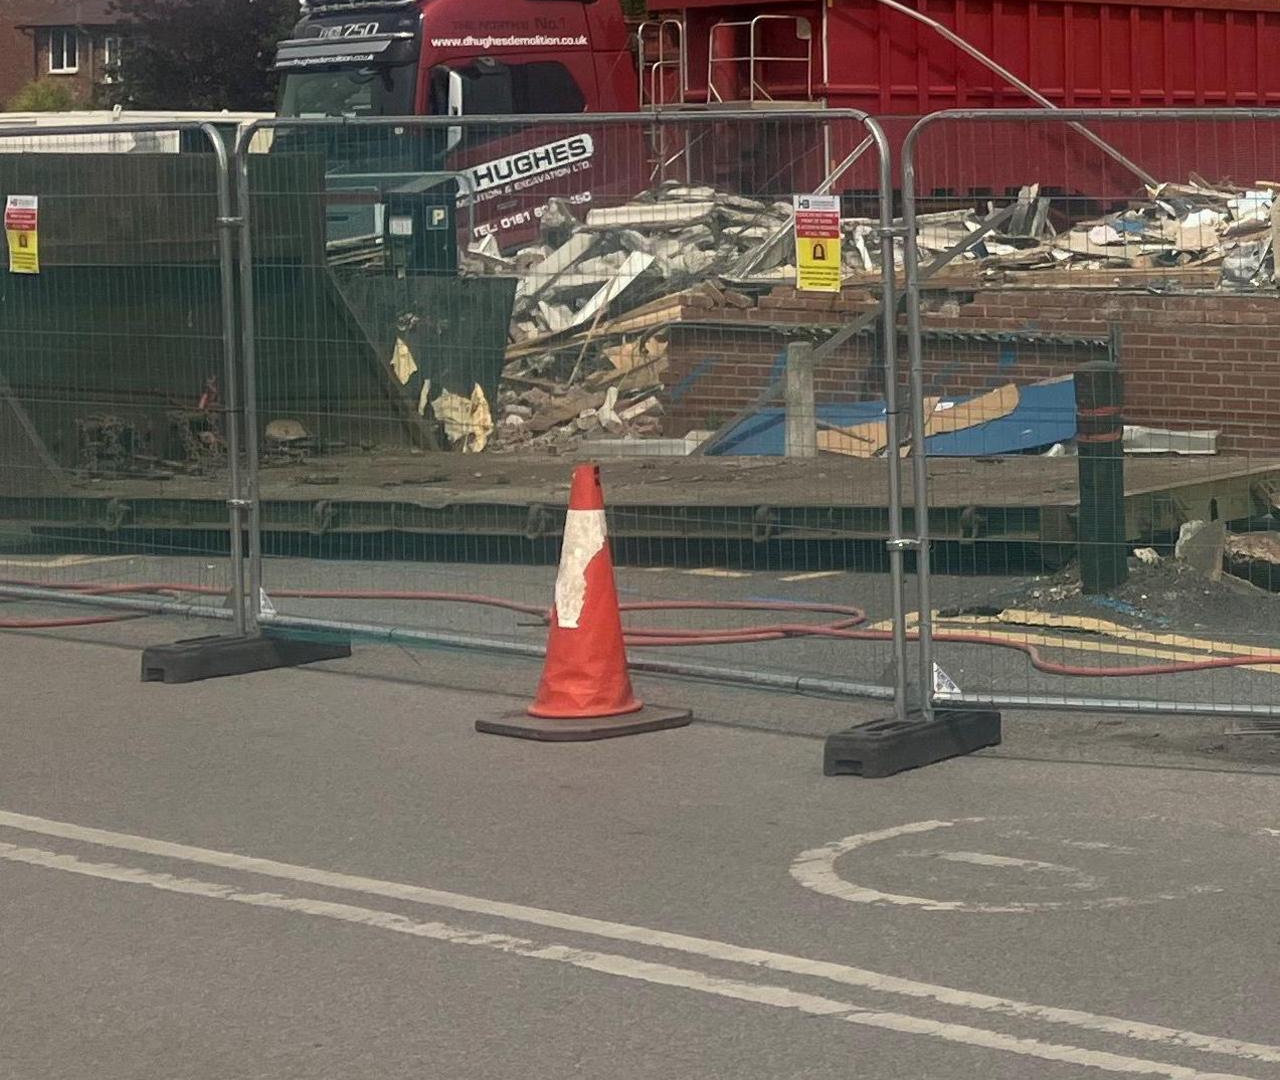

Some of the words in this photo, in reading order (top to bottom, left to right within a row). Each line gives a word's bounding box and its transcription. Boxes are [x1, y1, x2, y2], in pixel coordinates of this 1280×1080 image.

[431, 34, 588, 49] www.dhughesdemolition.co.uk
[472, 137, 588, 188] HUGHES
[514, 167, 571, 192] EXCAVATION
[432, 209, 445, 226] P
[473, 222, 499, 238] TEL:
[501, 210, 531, 229] 0161
